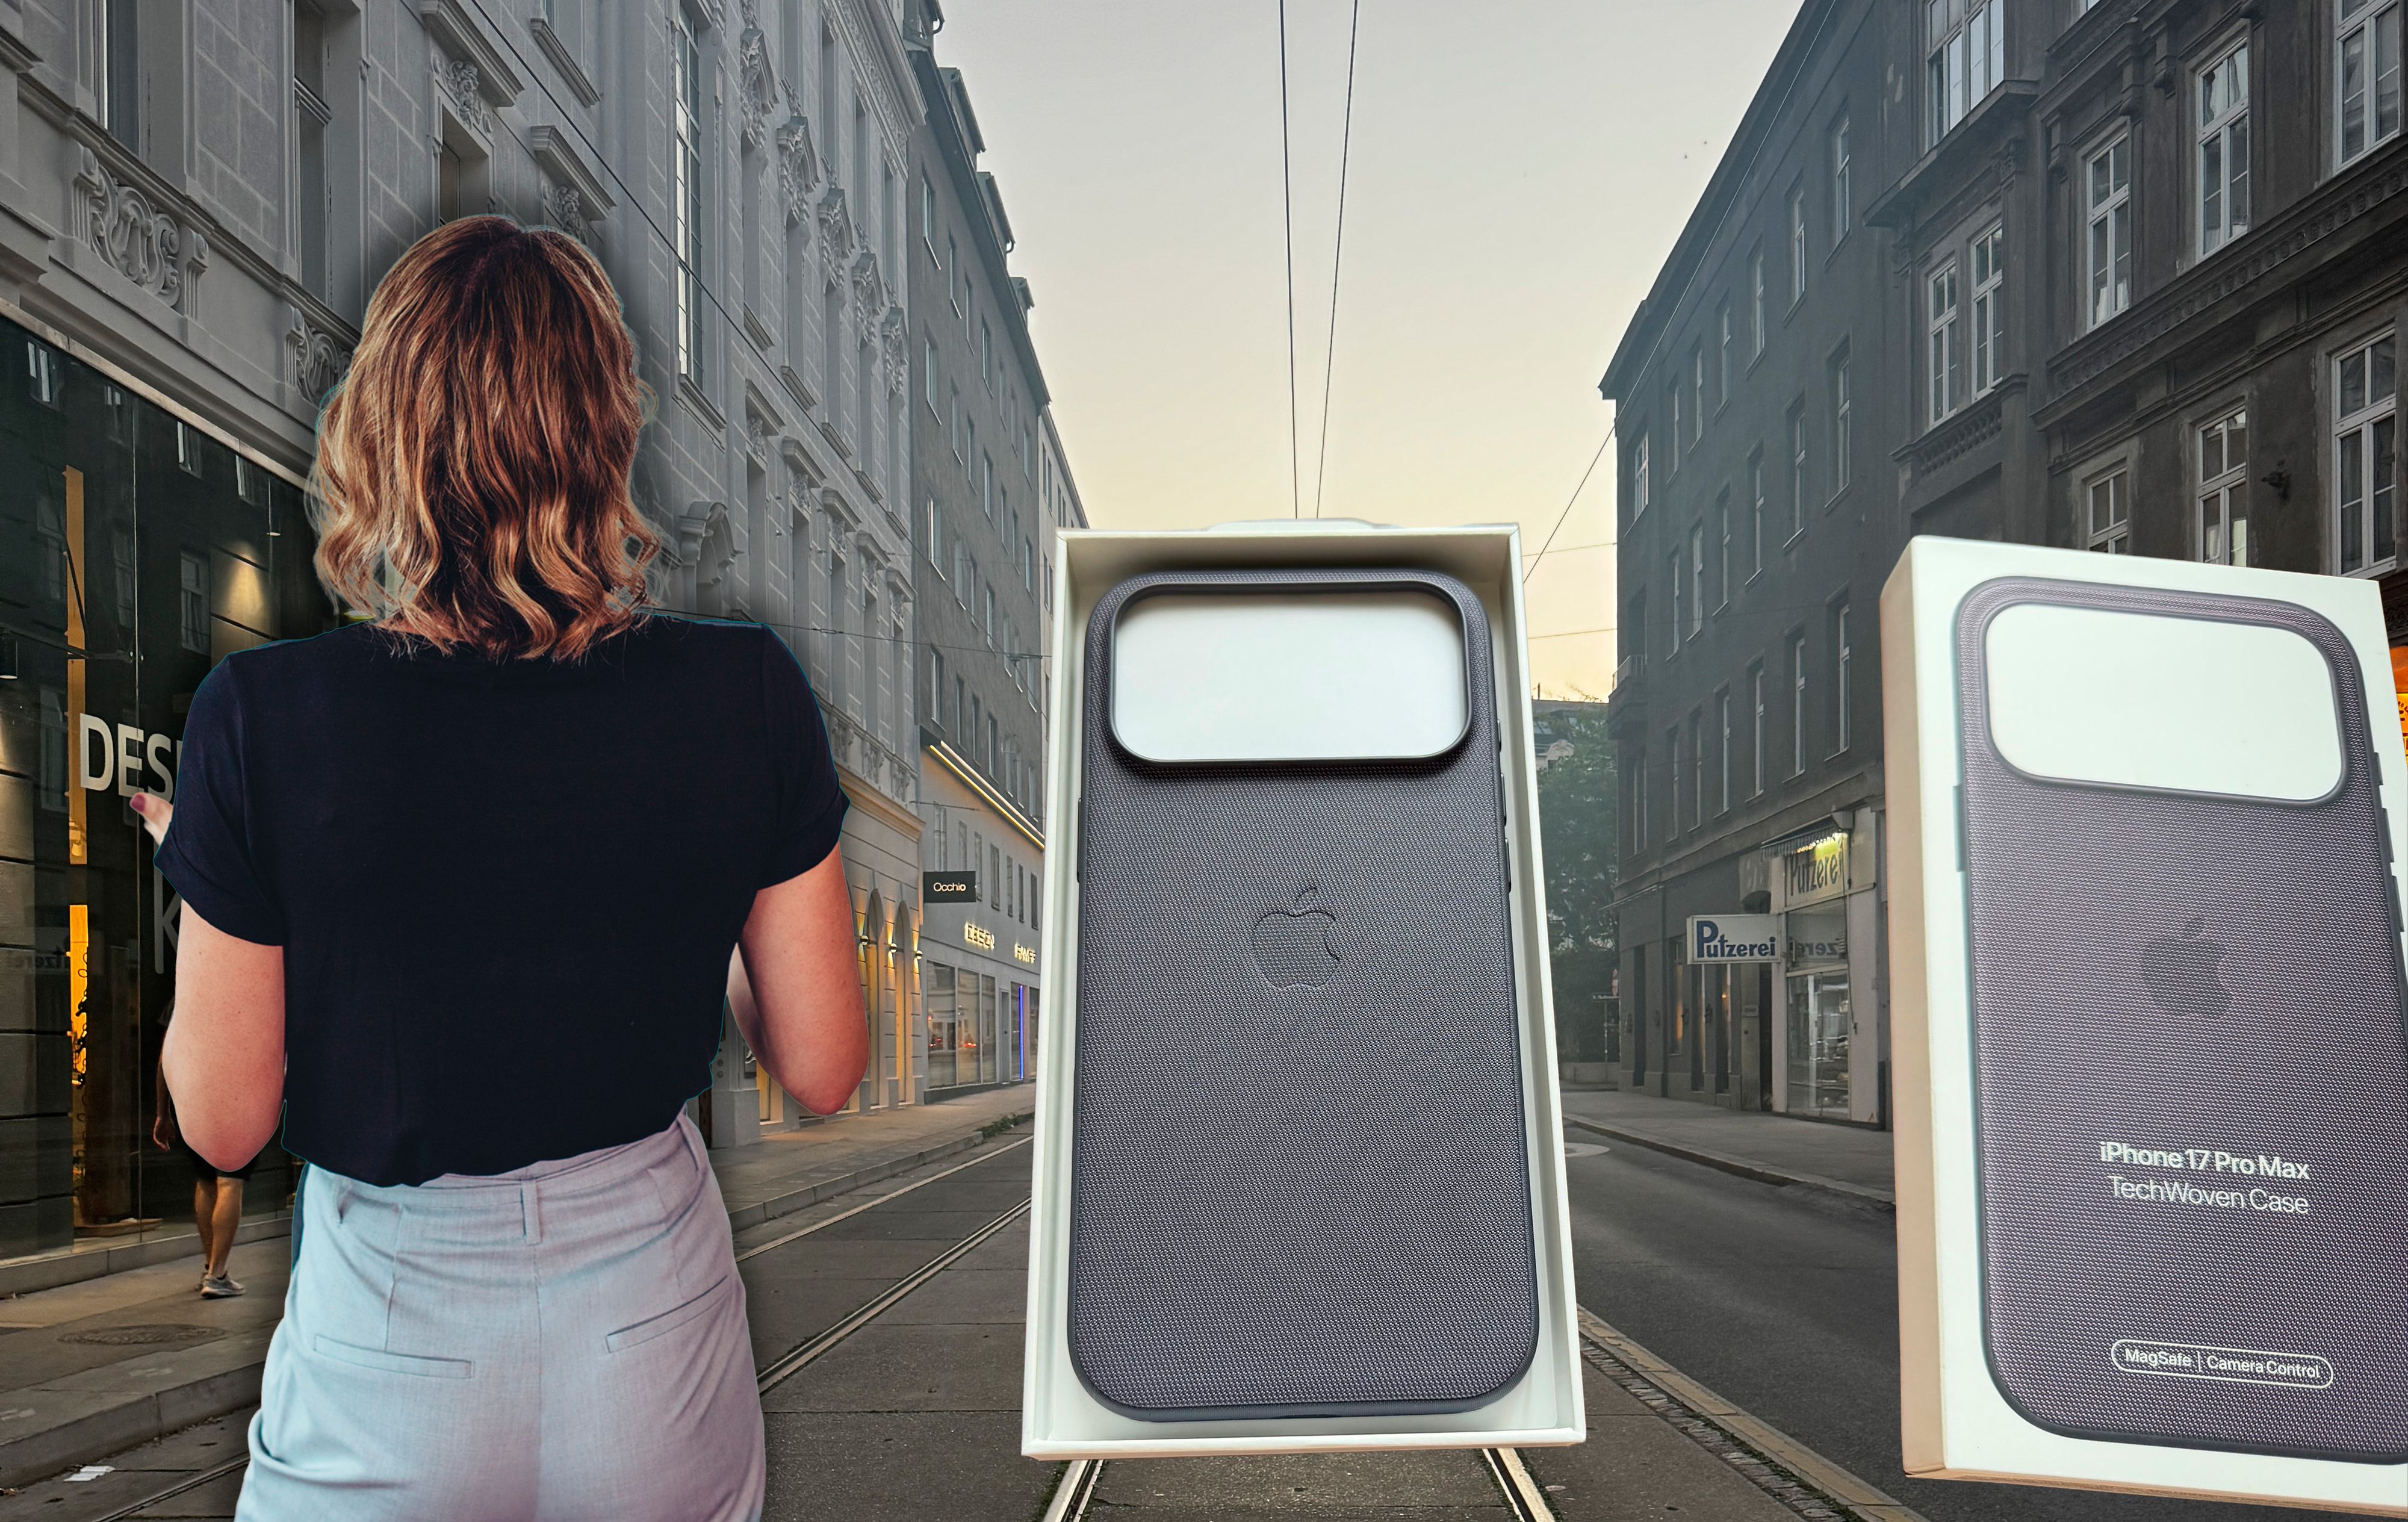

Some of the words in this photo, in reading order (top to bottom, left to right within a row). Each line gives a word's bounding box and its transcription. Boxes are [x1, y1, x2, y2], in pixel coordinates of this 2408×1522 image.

[933, 882, 966, 892] Occhio
[1696, 920, 1776, 958] Putzerei
[2100, 1140, 2182, 1169] iPhone
[2185, 1148, 2211, 1170] 17
[2214, 1151, 2254, 1175] Pro
[2258, 1155, 2310, 1180] Max
[2108, 1175, 2245, 1208] TechWoven
[2250, 1188, 2309, 1214] Case
[2125, 1348, 2192, 1367] MagSafe
[2207, 1355, 2264, 1373] Camera
[2266, 1361, 2320, 1378] Control
